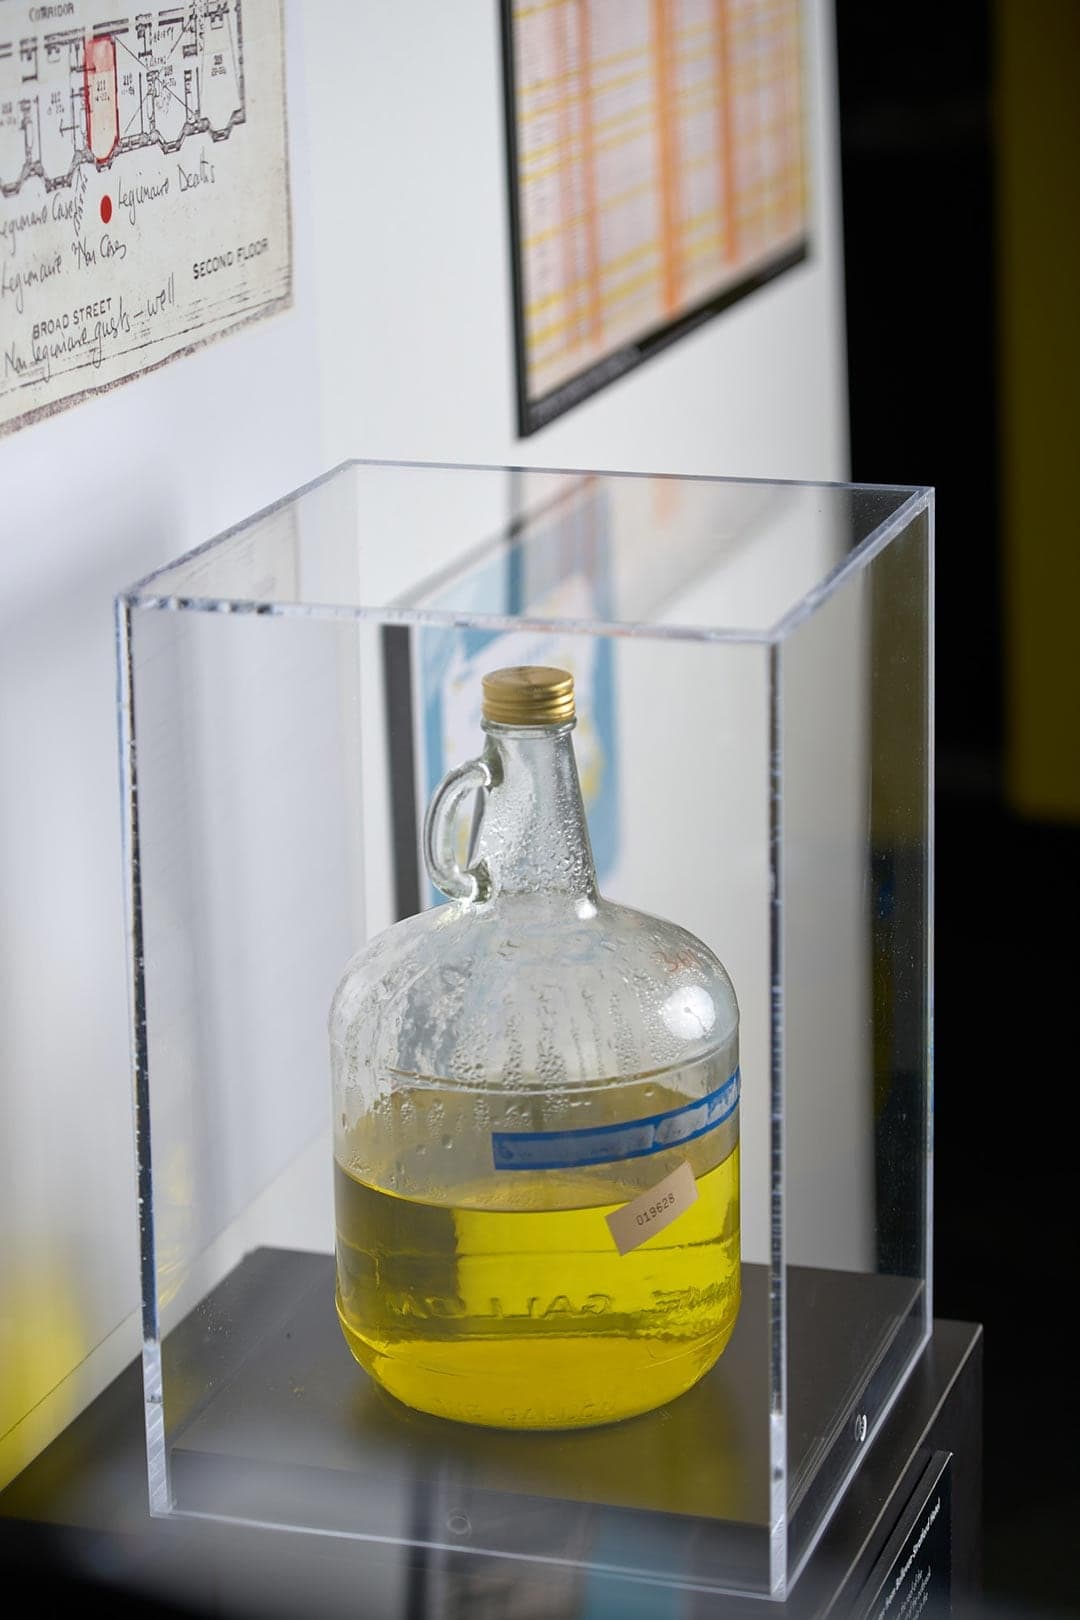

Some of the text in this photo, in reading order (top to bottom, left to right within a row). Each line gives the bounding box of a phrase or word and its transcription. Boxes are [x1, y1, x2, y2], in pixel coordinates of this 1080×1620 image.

[193, 238, 268, 280] SECOND FLOOR
[32, 297, 112, 340] BROAD STREET
[636, 1193, 675, 1226] 019628
